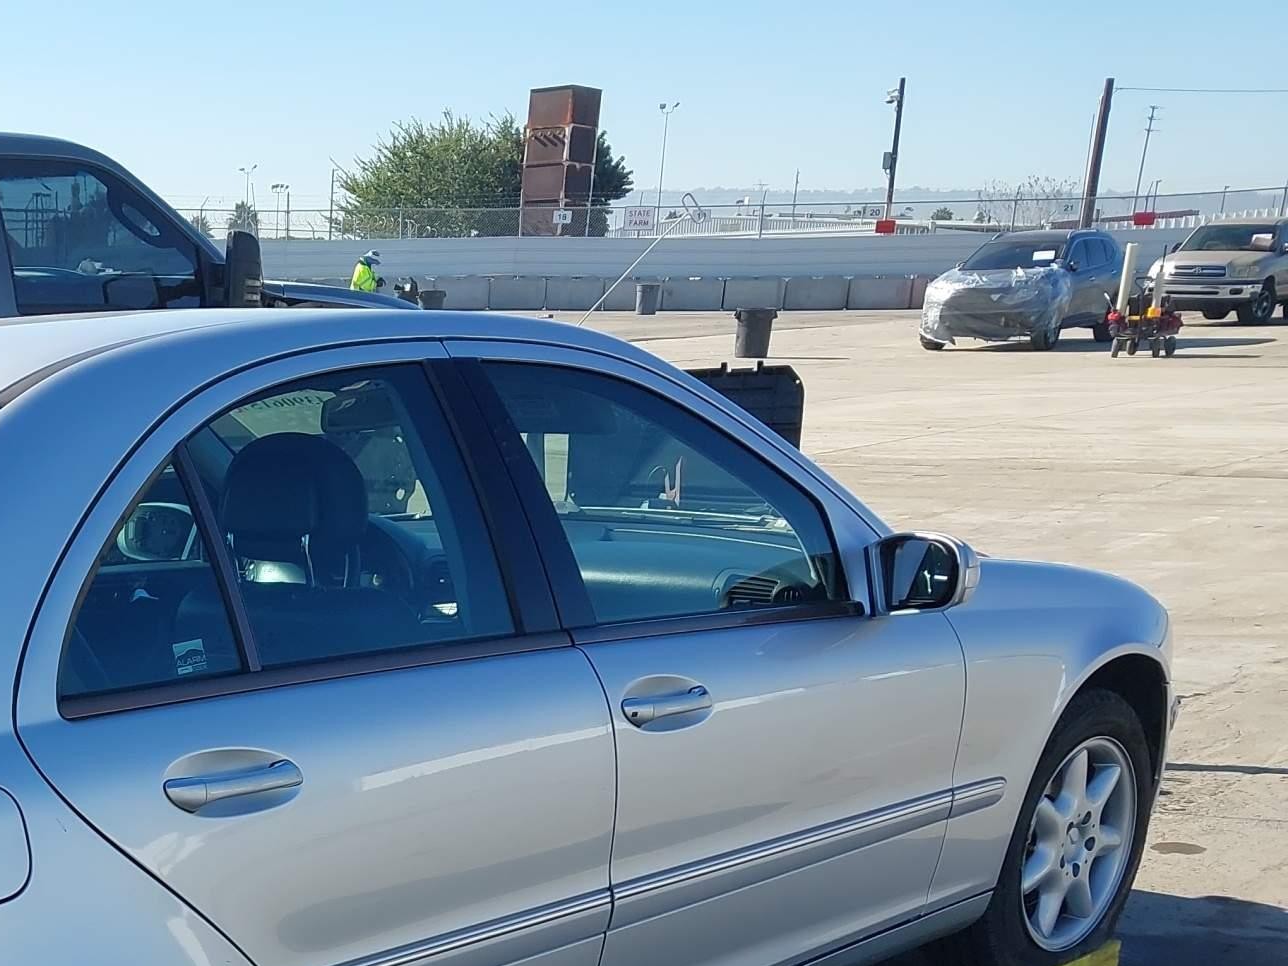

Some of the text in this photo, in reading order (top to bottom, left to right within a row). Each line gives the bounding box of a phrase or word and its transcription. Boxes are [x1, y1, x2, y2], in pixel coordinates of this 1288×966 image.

[1063, 204, 1074, 212] 21
[628, 210, 651, 218] STATE
[869, 208, 881, 217] 20
[628, 219, 649, 227] FARM
